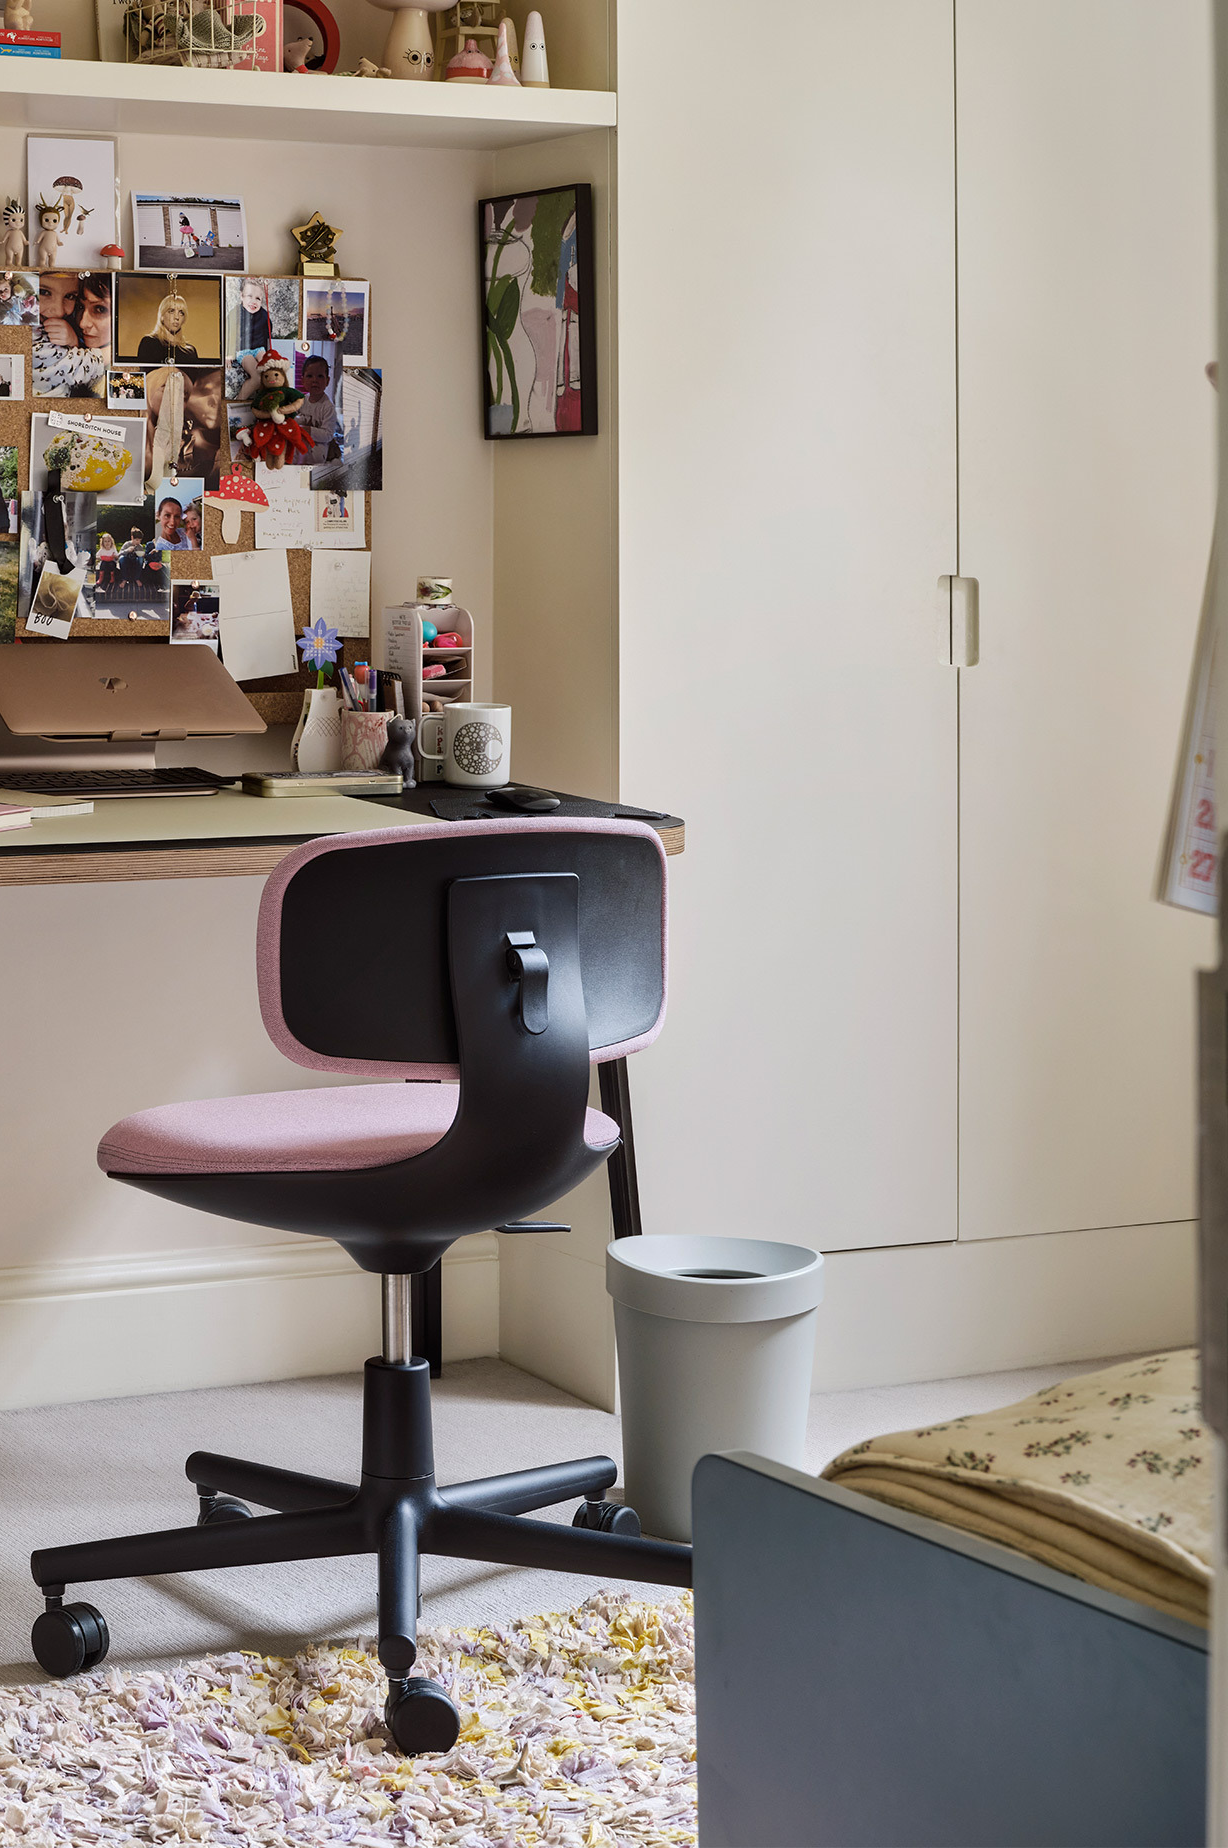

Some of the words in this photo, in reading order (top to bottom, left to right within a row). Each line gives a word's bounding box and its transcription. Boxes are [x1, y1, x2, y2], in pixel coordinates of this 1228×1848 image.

[67, 420, 102, 432] SHOREDITCH
[102, 428, 122, 437] HOUSE
[34, 611, 53, 626] BOO
